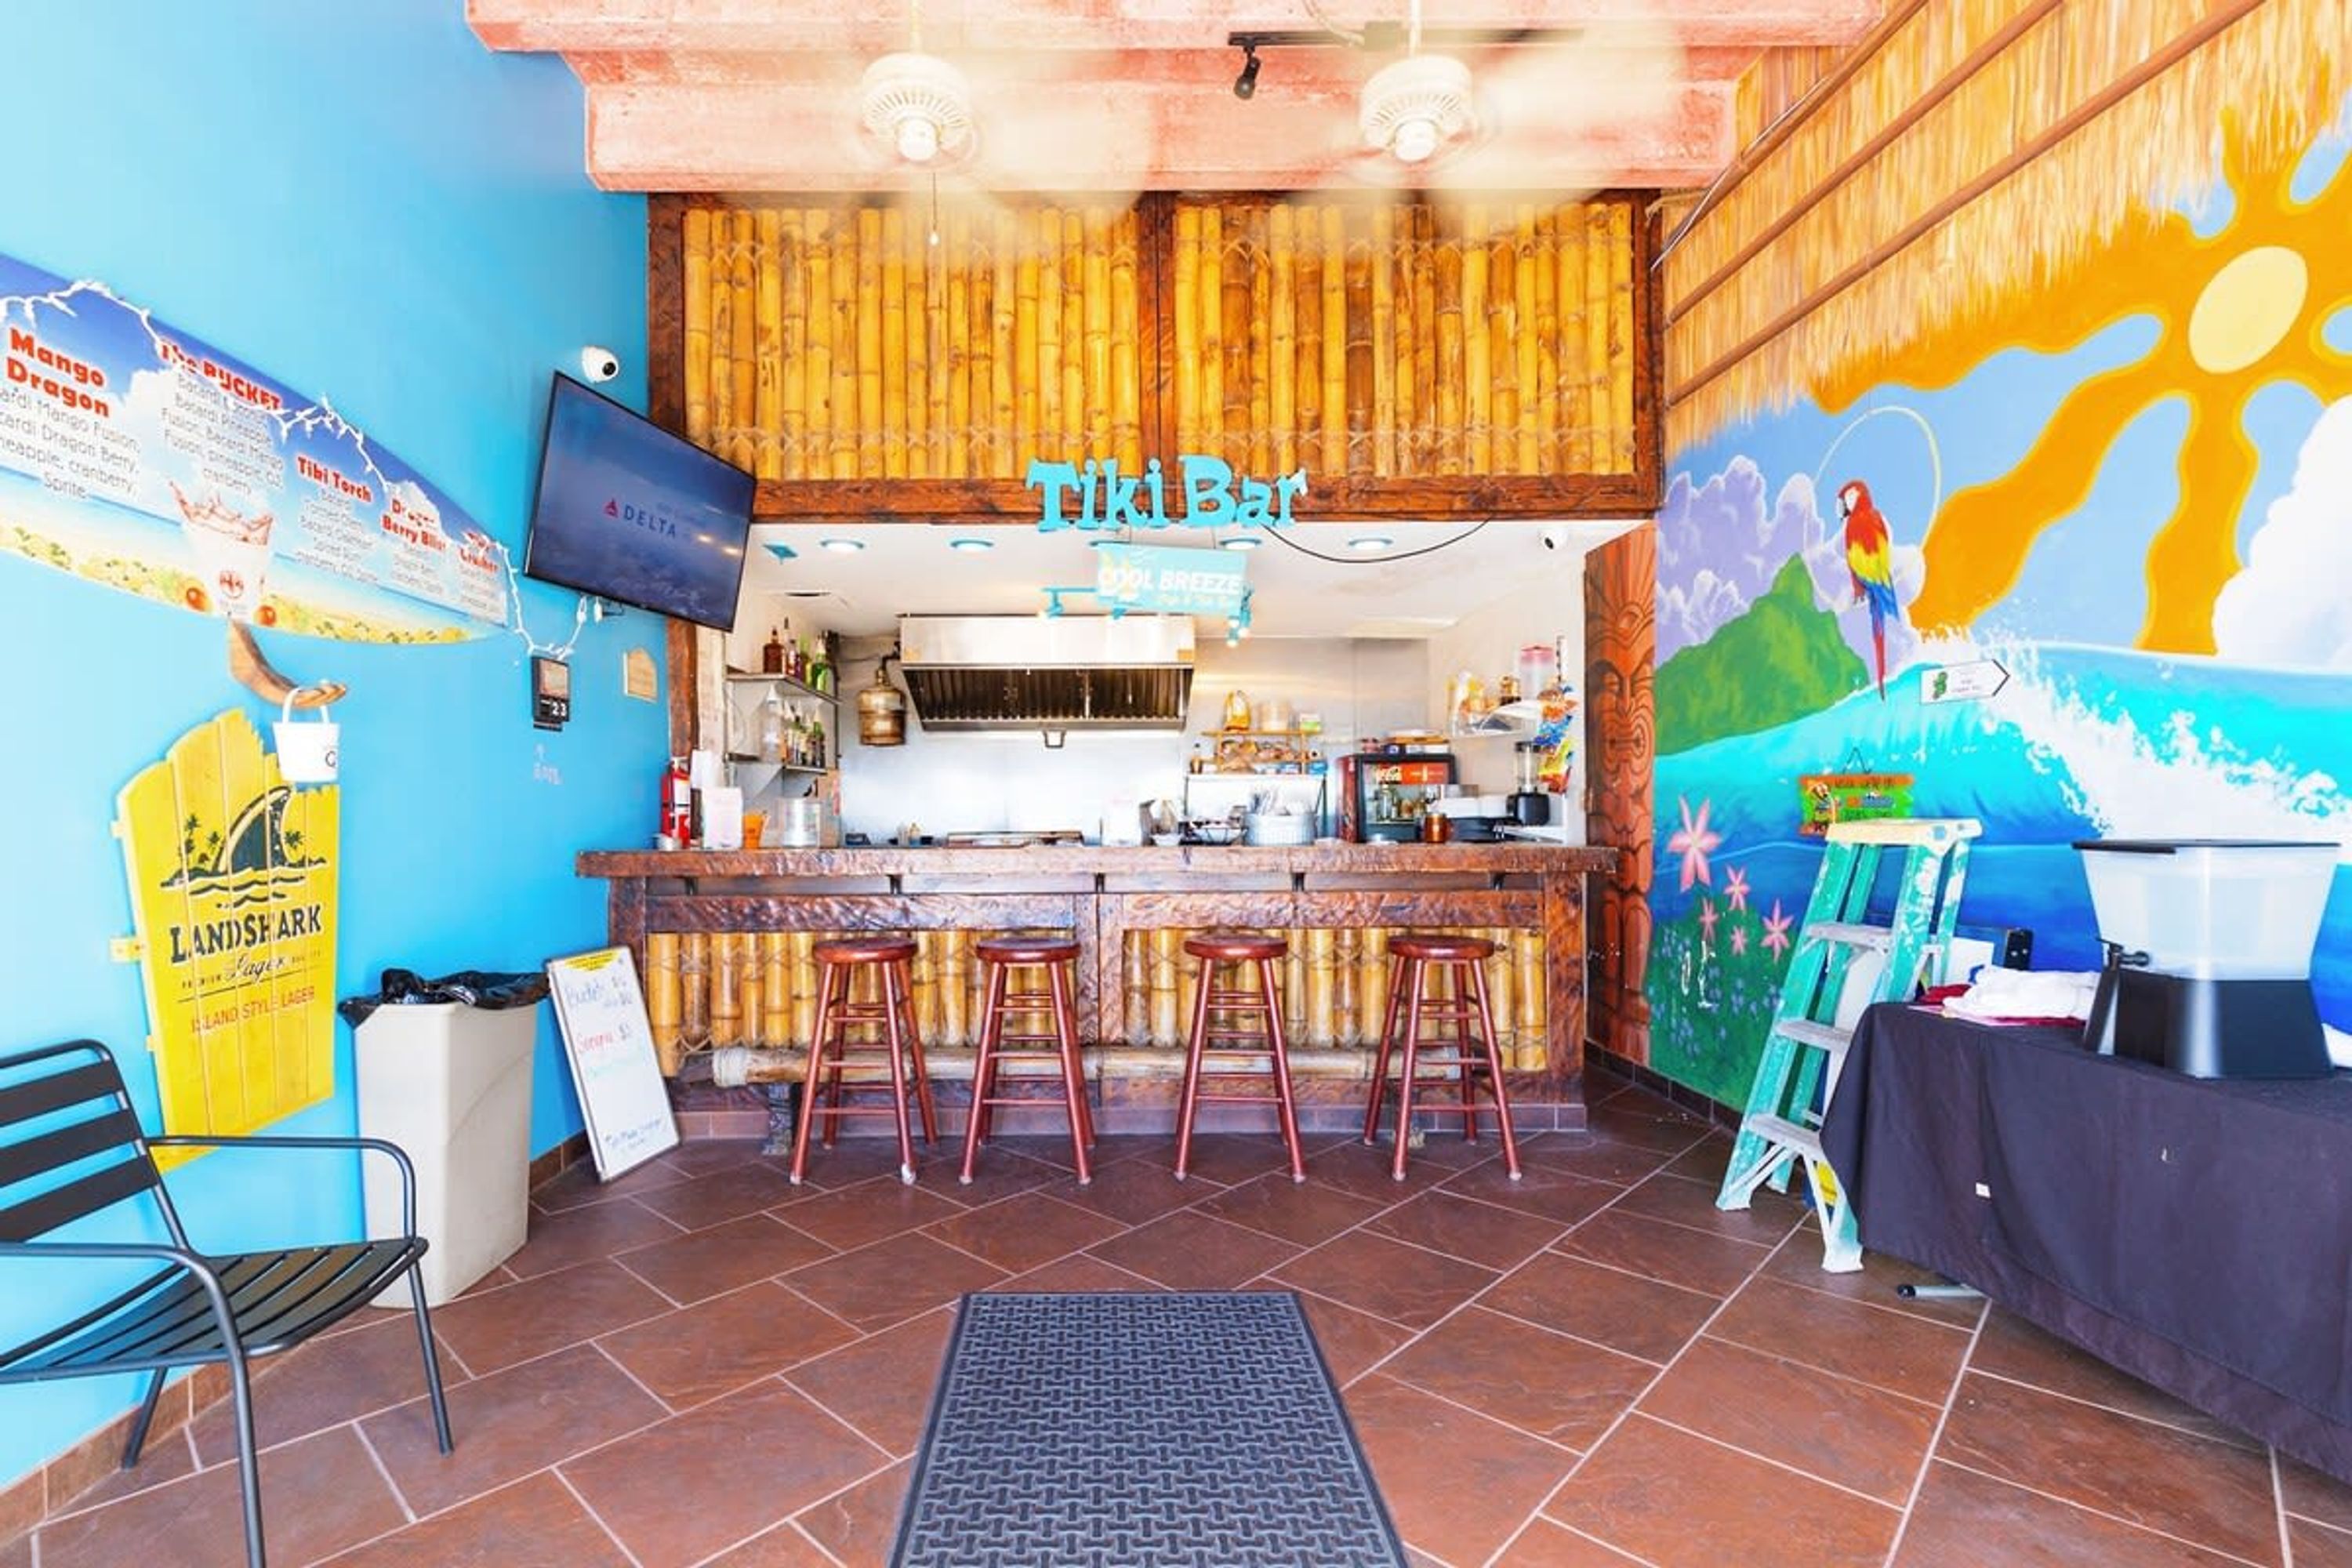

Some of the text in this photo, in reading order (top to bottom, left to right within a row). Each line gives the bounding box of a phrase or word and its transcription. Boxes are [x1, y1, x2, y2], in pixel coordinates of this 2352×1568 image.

[10, 327, 104, 387] Mango
[7, 357, 109, 417] Dragon
[38, 400, 89, 432] Mango
[42, 424, 96, 457] Dragon
[44, 471, 87, 499] Sprite
[333, 472, 372, 503] Torch
[1025, 455, 1308, 532] Tiki Bar
[383, 514, 417, 544] Berry
[624, 504, 676, 539] DELTA
[1098, 566, 1243, 593] COOL BREEZE
[170, 904, 321, 964] LANDSHARK
[281, 985, 314, 1008] LAGER
